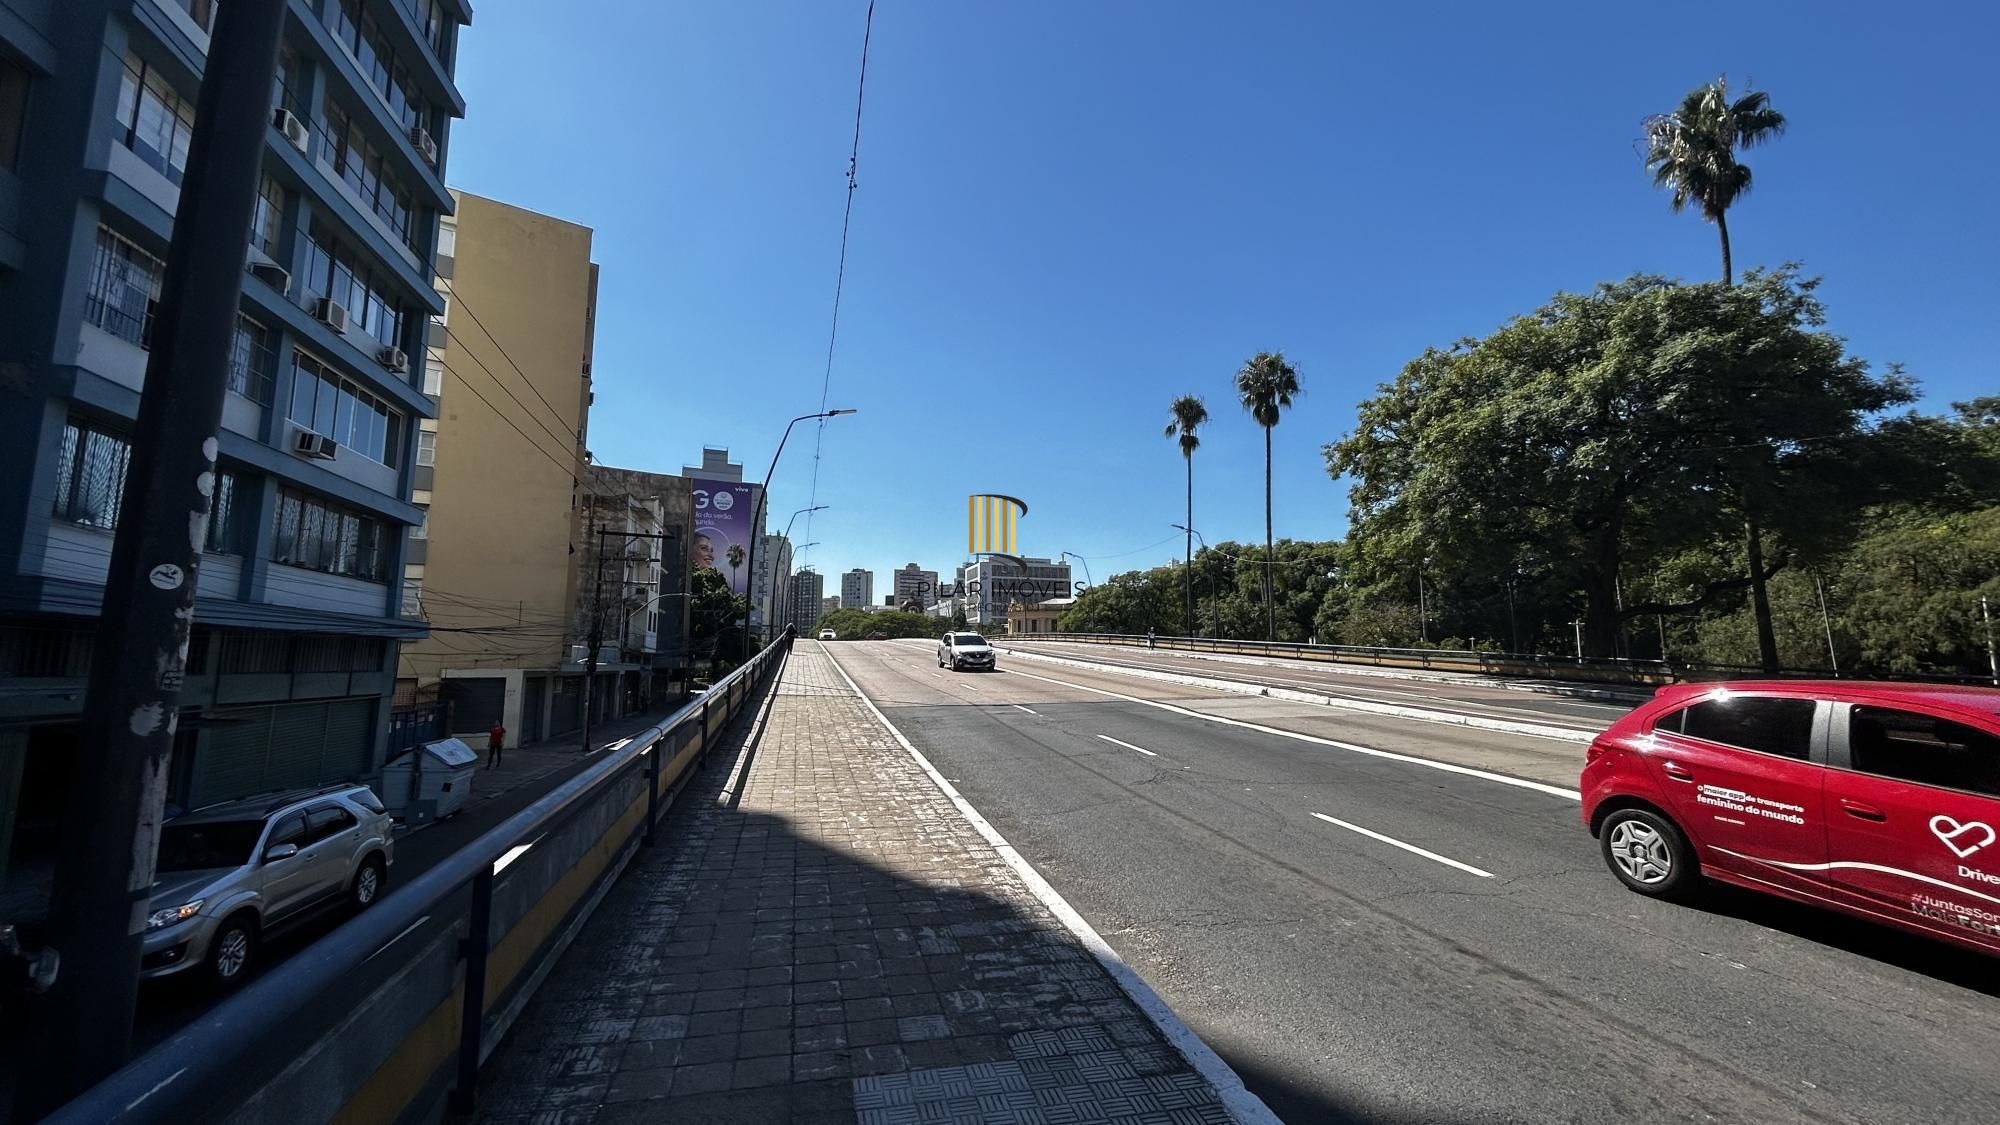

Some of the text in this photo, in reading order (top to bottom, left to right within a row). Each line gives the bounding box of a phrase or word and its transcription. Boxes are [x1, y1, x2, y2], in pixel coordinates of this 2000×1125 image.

[1697, 794, 1744, 811] feminino
[1745, 805, 1760, 815] do
[1761, 809, 1804, 825] mundo
[1704, 787, 1727, 796] maior
[1729, 792, 1745, 800] app
[1757, 797, 1804, 812] transporte
